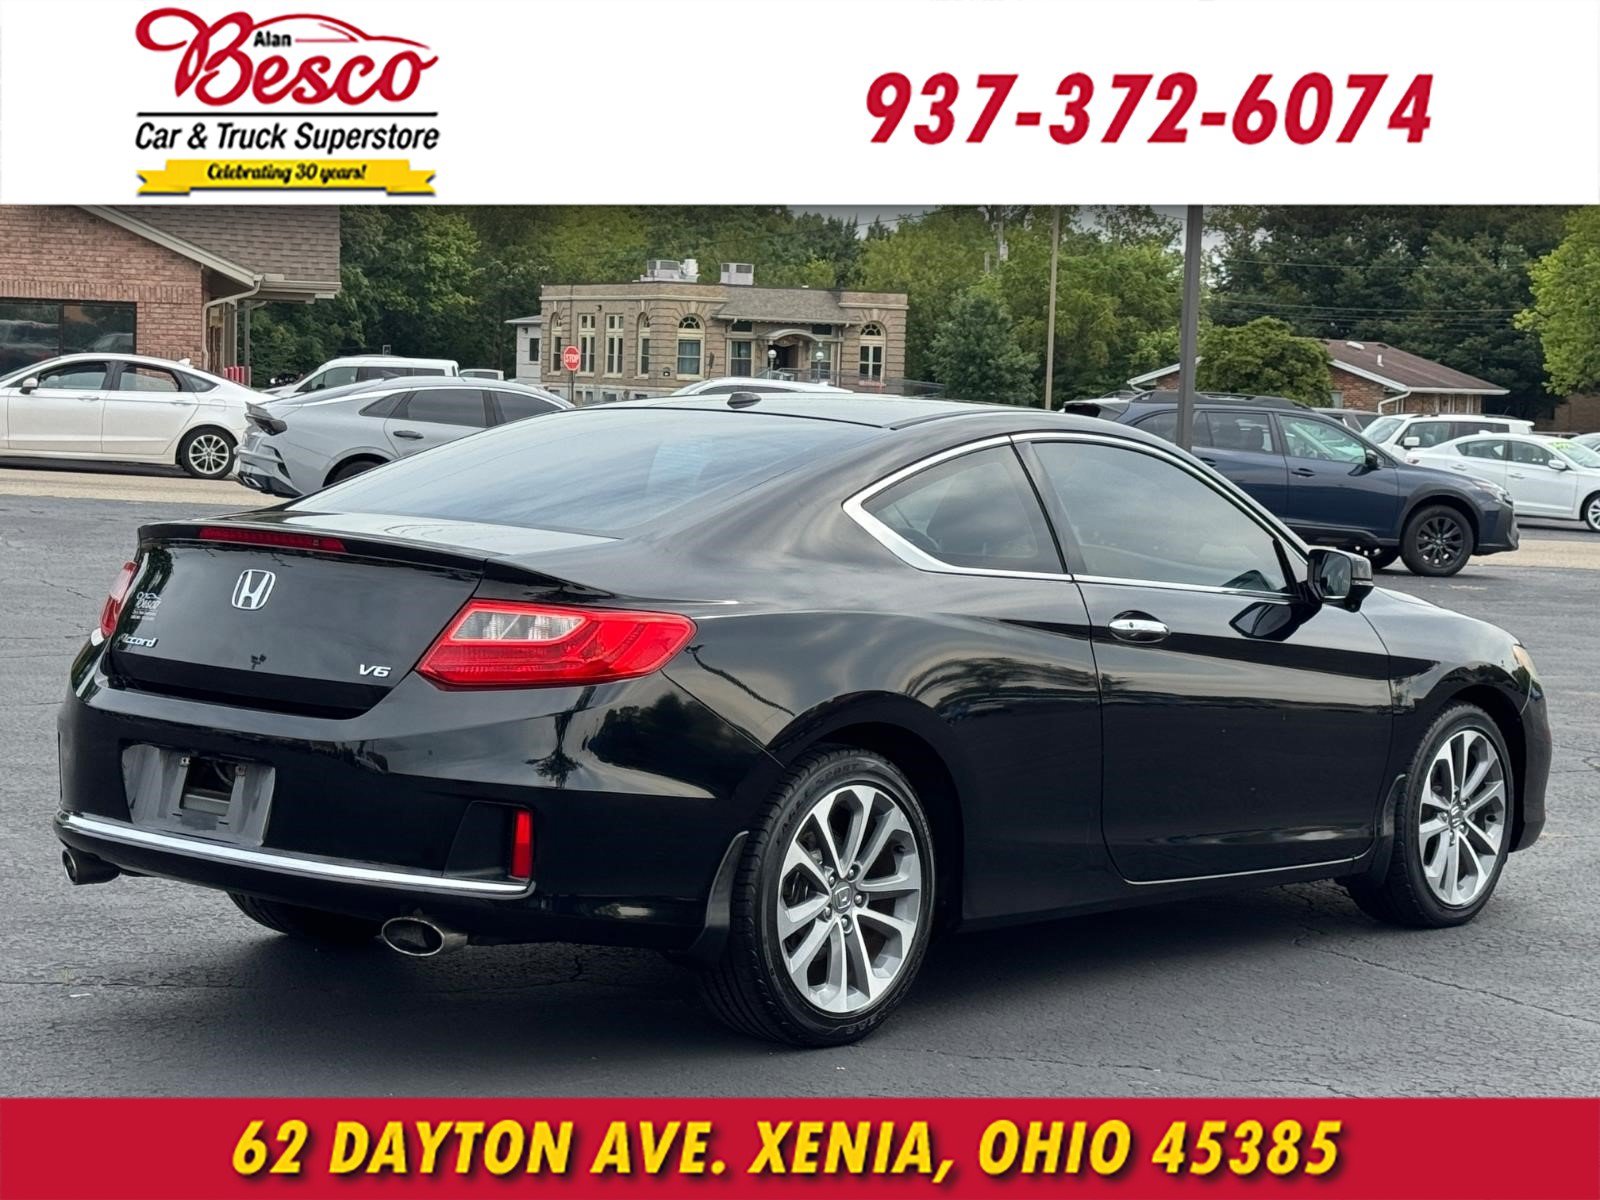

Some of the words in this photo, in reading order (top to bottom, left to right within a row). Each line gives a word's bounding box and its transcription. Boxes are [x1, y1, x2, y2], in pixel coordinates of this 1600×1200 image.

[565, 353, 579, 363] STOP
[119, 633, 157, 647] Accord
[359, 663, 391, 677] V6
